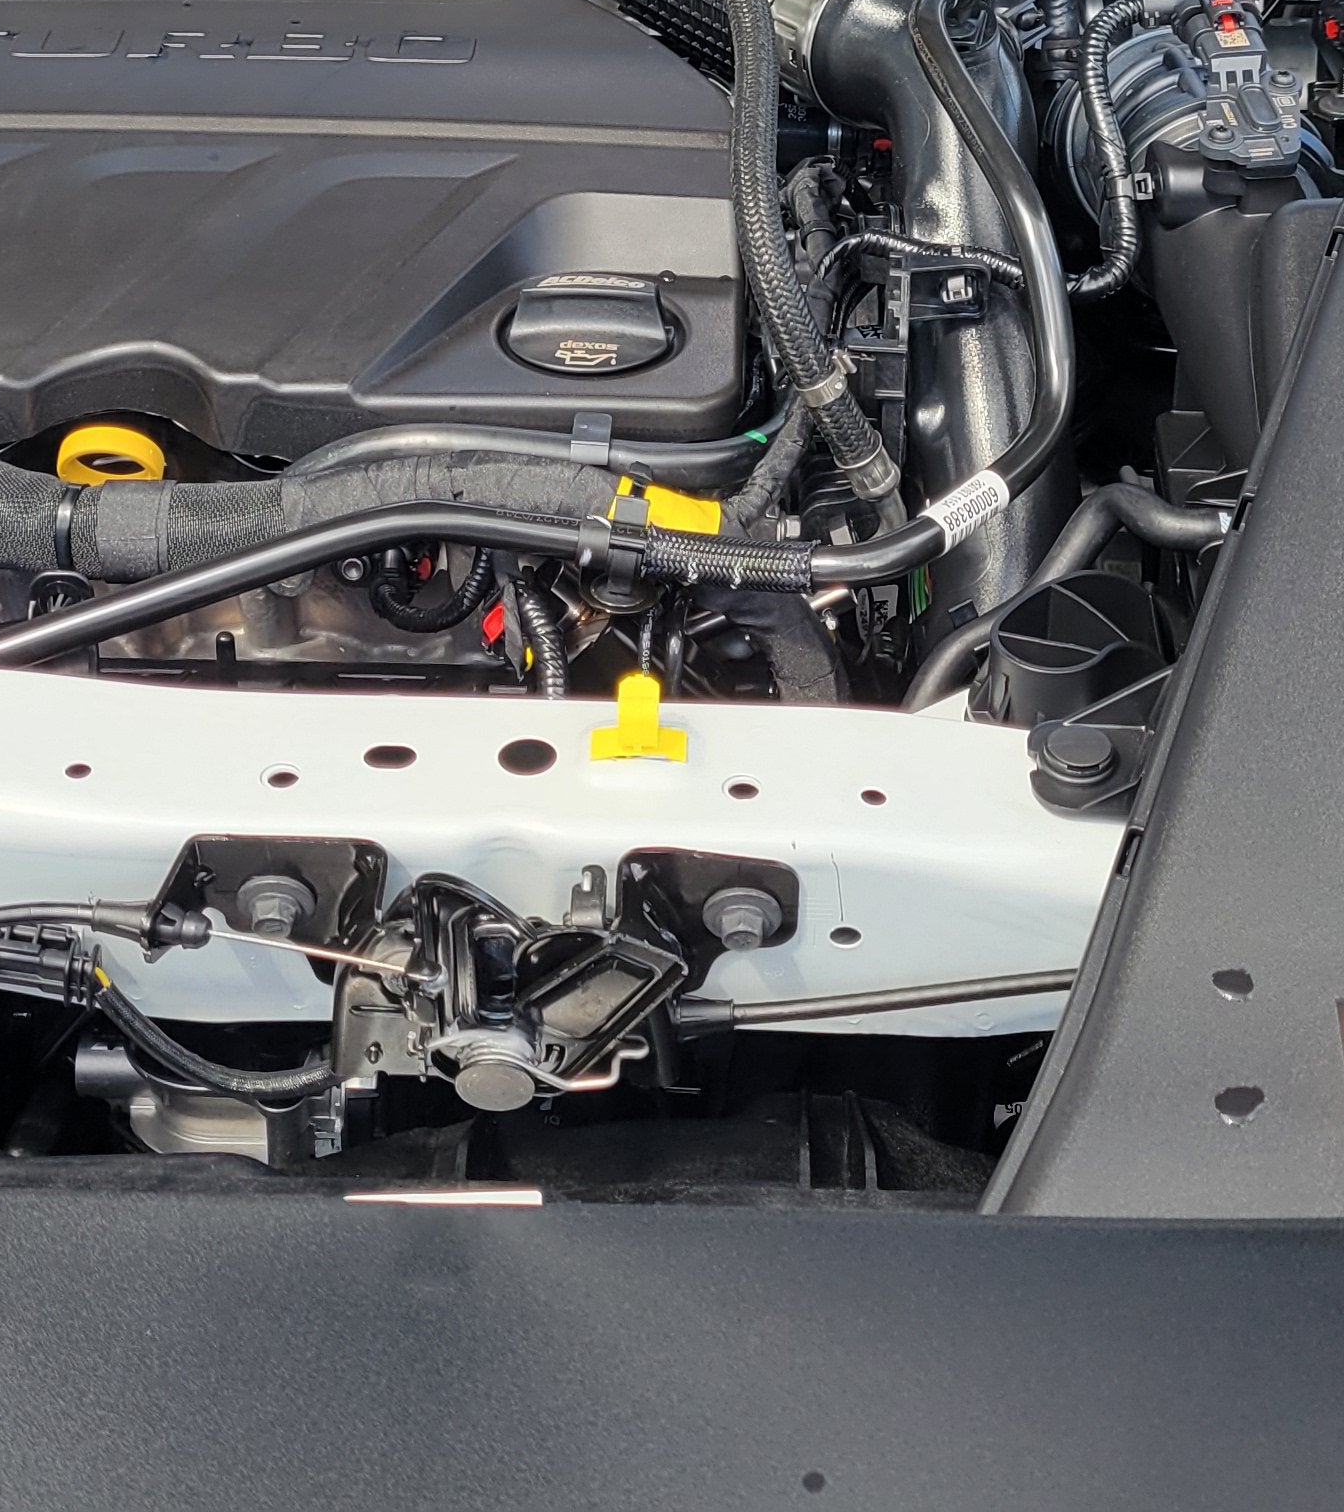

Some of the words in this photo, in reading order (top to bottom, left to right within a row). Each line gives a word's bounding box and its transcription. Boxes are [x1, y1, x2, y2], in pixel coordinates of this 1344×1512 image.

[536, 275, 646, 289] ACDelco
[559, 340, 622, 351] dexos
[943, 486, 1000, 532] 60008388
